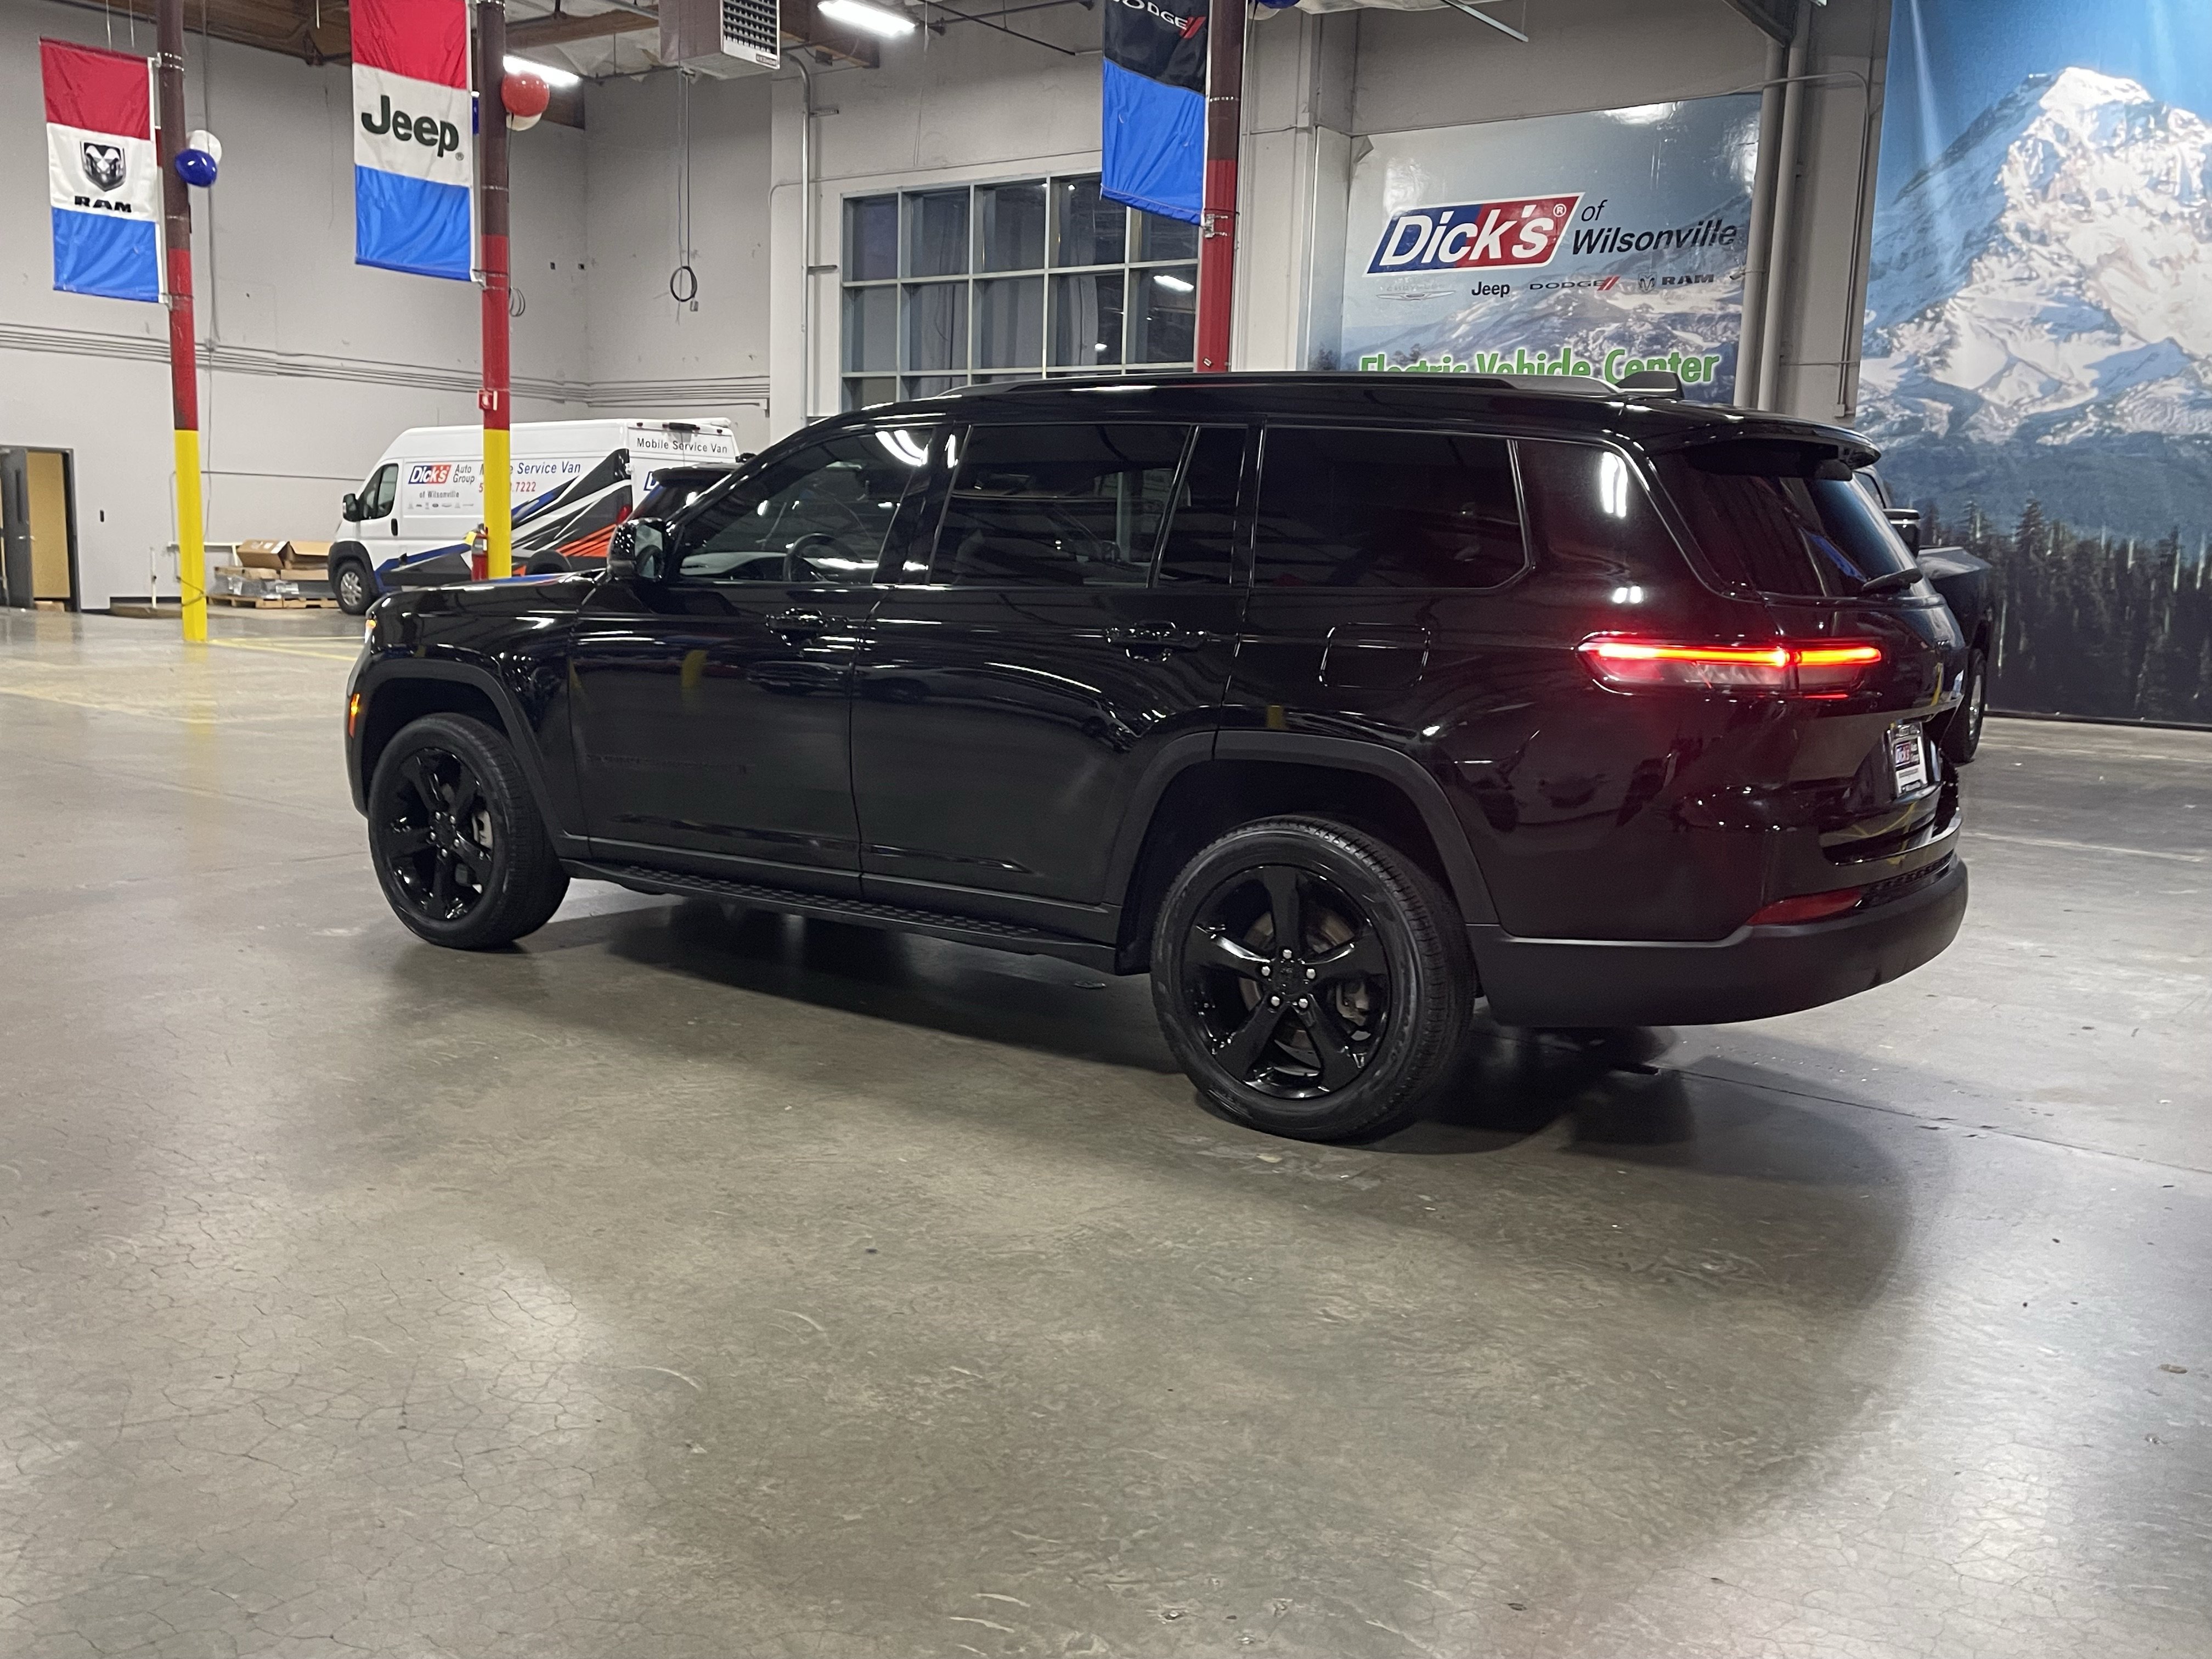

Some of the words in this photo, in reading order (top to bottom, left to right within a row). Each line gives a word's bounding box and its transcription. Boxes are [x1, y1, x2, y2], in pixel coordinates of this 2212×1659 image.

[1113, 0, 1188, 30] ODGE
[361, 95, 459, 158] Jeep
[75, 195, 132, 213] RAM
[1581, 199, 1607, 222] of
[1572, 219, 1737, 255] Wilsonville
[1530, 280, 1606, 290] DODGE
[1662, 274, 1714, 285] RAM
[1471, 281, 1510, 297] Jeep
[637, 438, 669, 449] Mobile
[673, 441, 707, 452] Service
[711, 443, 727, 453] Van
[455, 464, 472, 473] Auto
[517, 461, 557, 475] Service
[562, 461, 581, 473] Van
[453, 473, 475, 485] Group
